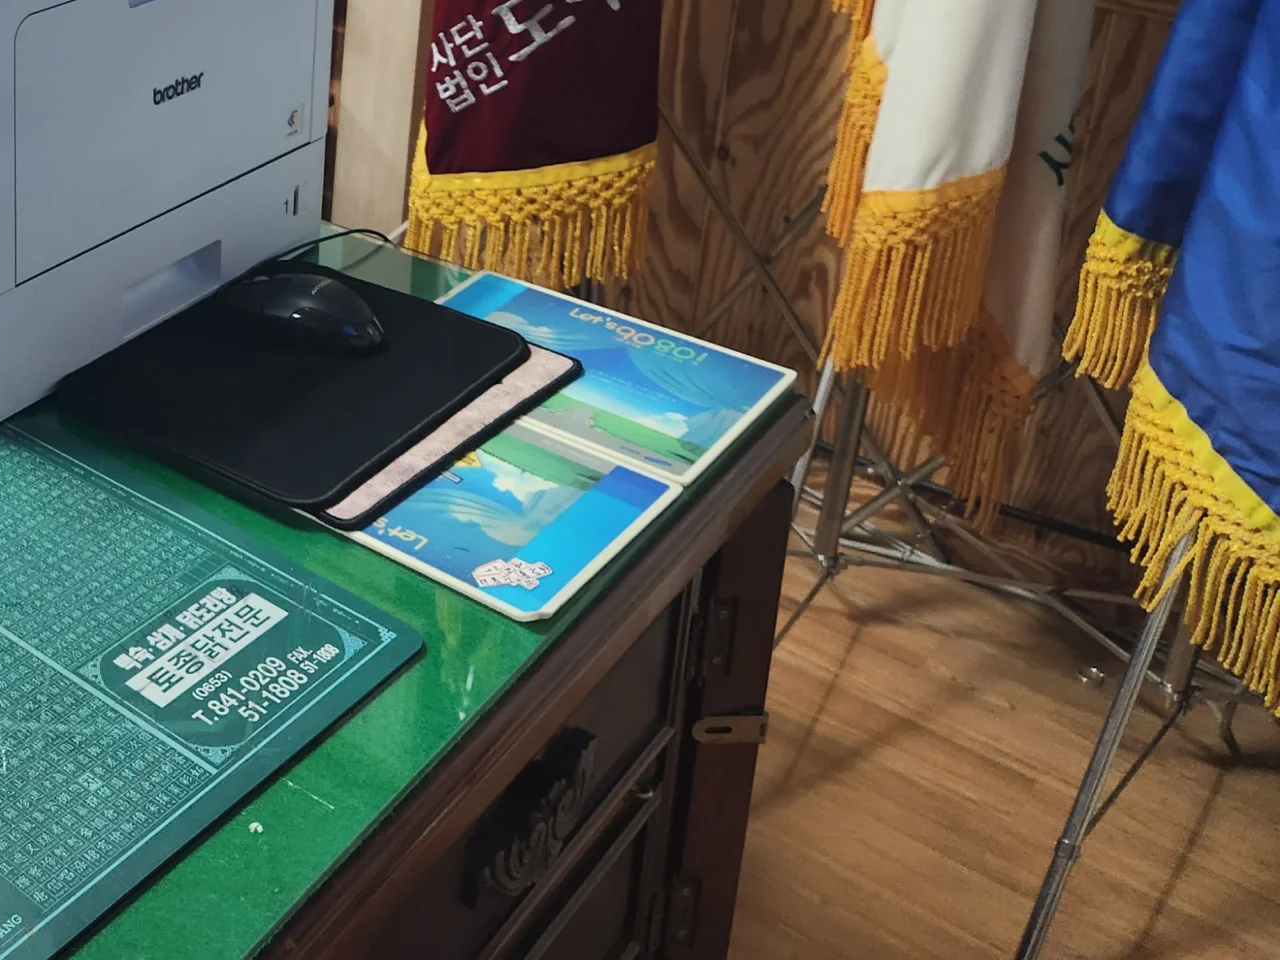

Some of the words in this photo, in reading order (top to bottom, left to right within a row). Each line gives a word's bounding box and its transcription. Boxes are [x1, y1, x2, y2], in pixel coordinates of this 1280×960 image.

[430, 14, 490, 73] 사단
[153, 71, 204, 106] brother
[435, 52, 509, 113] 법인
[569, 307, 617, 332] Let's
[146, 604, 272, 693] 토종닭전문
[299, 643, 340, 674] 51-1808
[192, 670, 233, 701] (0653)
[238, 669, 308, 723] 51-1808
